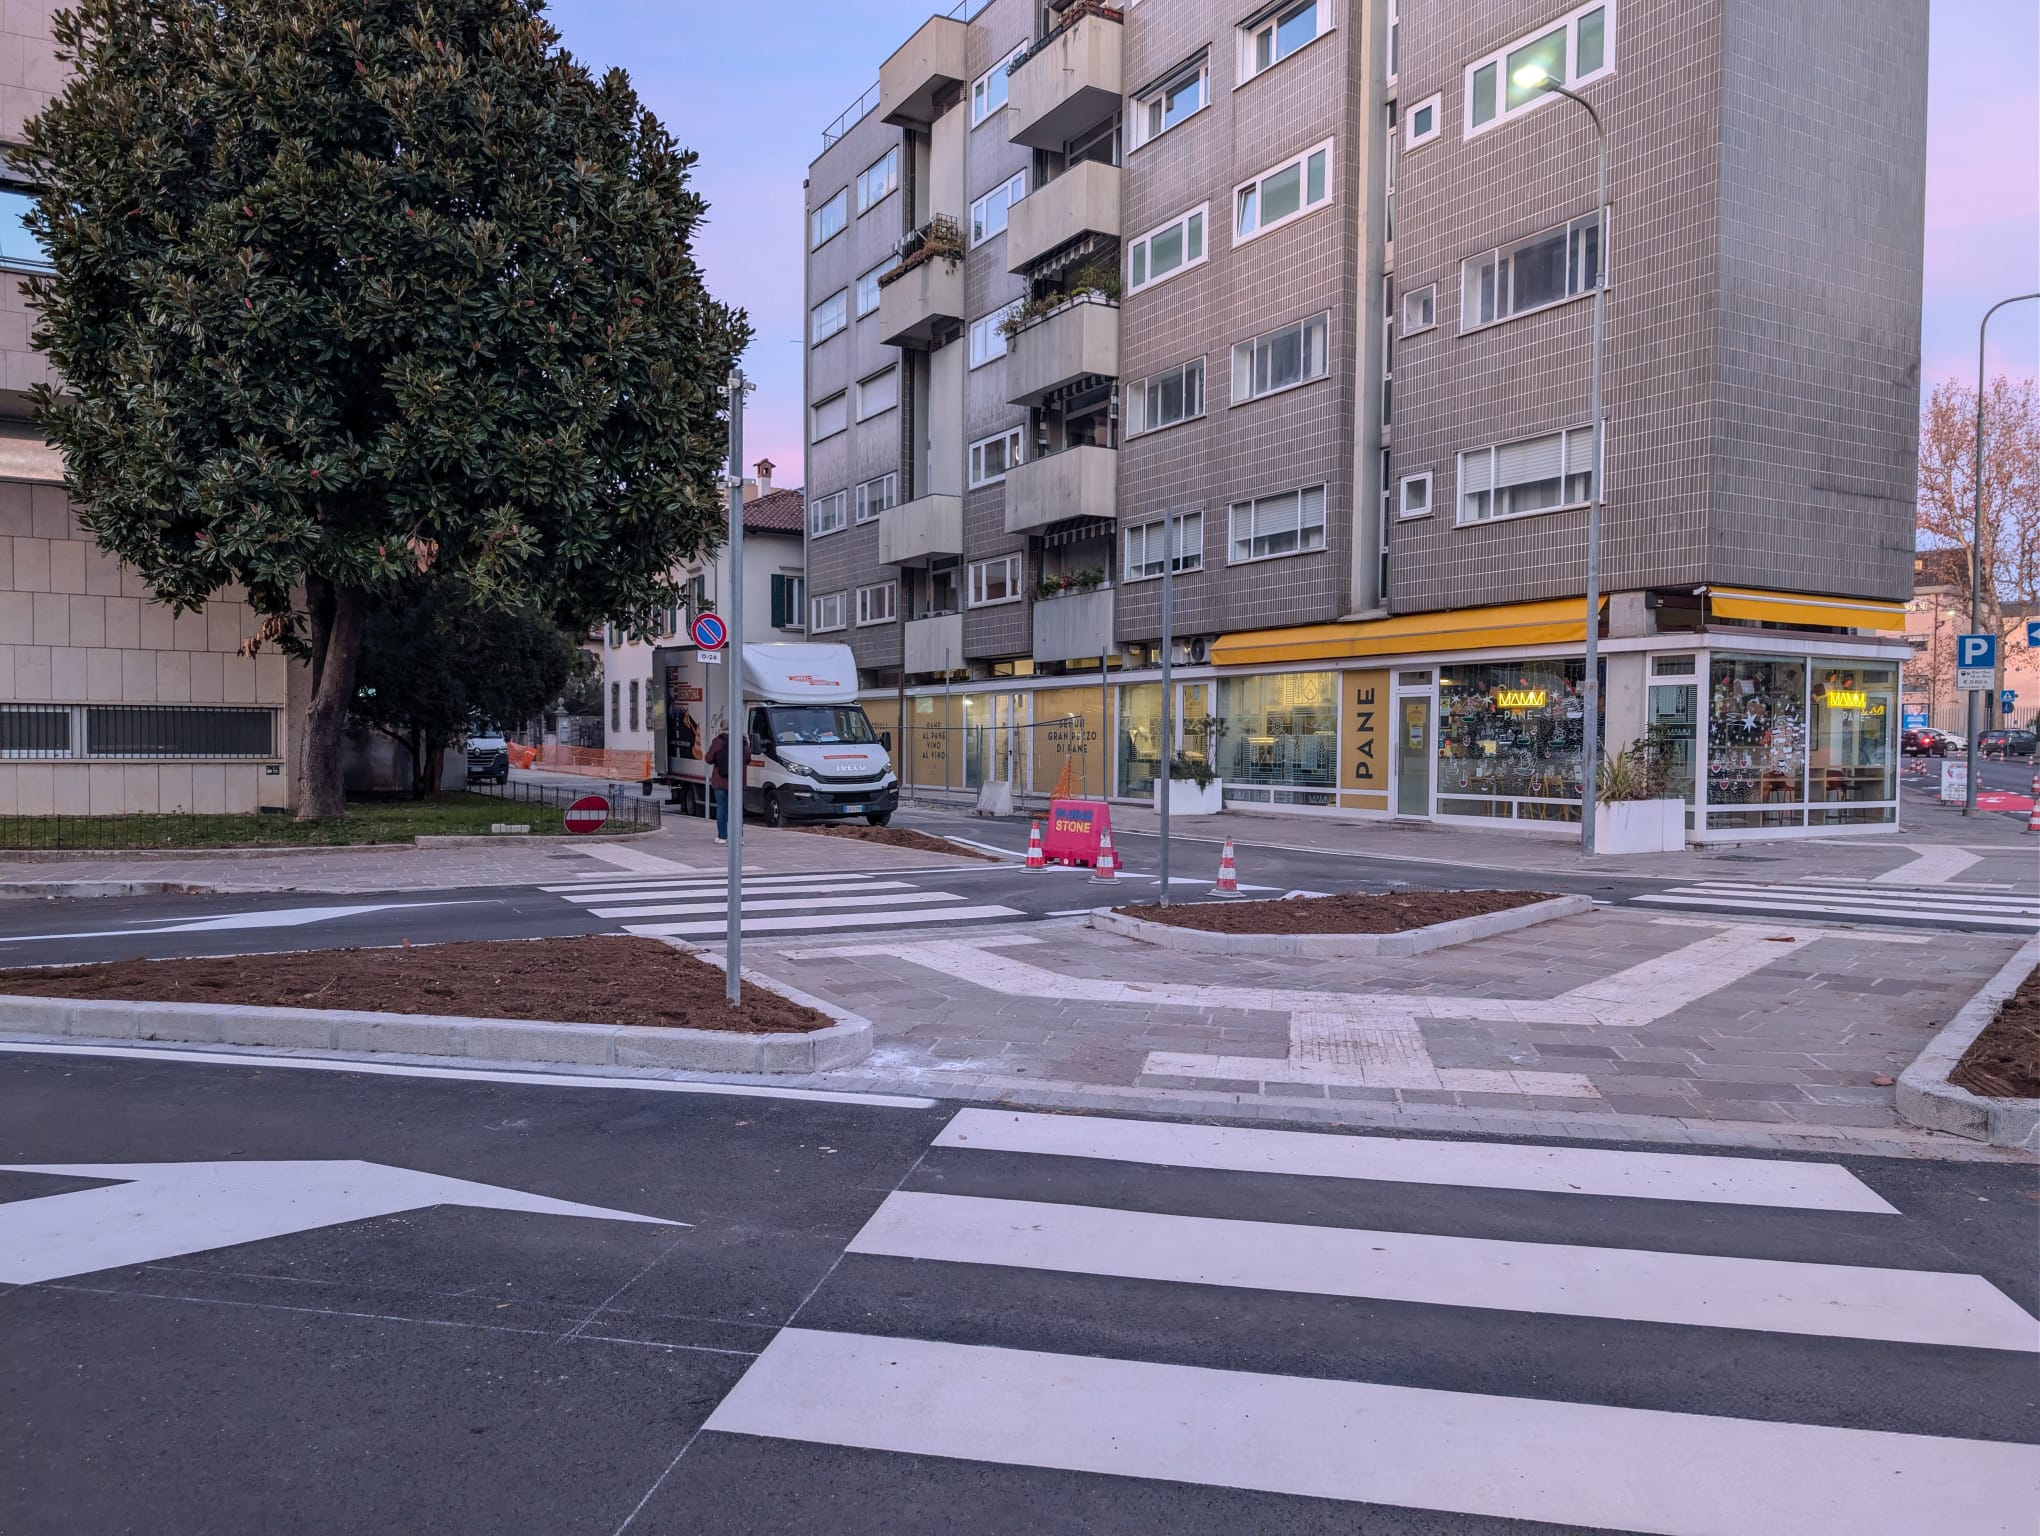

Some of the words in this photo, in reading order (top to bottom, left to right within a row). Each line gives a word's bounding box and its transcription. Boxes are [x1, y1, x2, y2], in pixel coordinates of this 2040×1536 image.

[702, 653, 717, 661] 0-24
[1965, 638, 1988, 665] P
[1499, 690, 1544, 706] MAMM
[1829, 690, 1866, 707] MAMM
[1047, 731, 1069, 741] GRAN
[1355, 688, 1375, 779] PANE
[926, 741, 941, 750] VINO
[1056, 744, 1065, 753] DI
[931, 751, 946, 759] VINO
[1055, 819, 1091, 833] STONE
